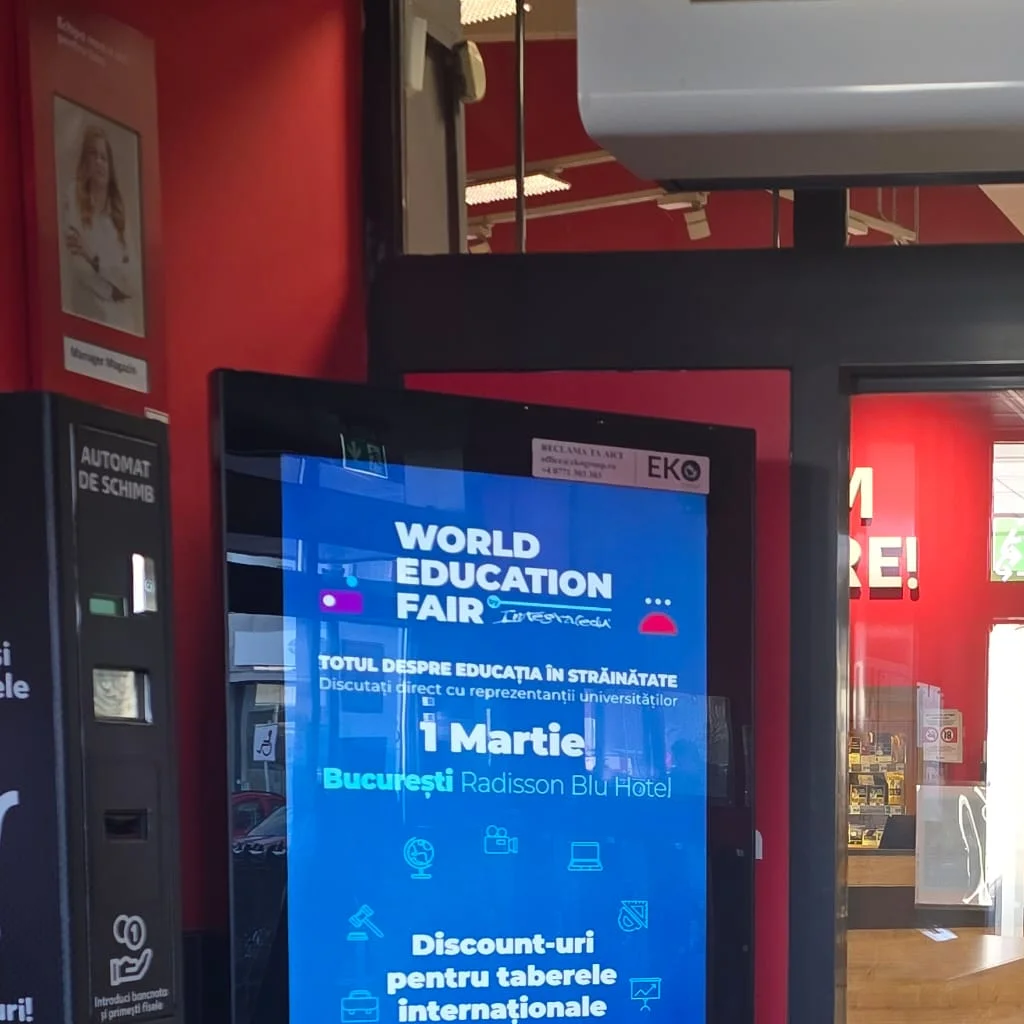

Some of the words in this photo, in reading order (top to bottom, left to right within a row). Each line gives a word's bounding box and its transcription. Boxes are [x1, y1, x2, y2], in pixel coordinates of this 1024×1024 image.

[81, 446, 151, 478] AUTOMAT
[79, 470, 99, 492] DE
[102, 475, 155, 503] SCHIMB
[395, 522, 540, 558] WORLD
[396, 558, 612, 598] EDUCATION
[397, 593, 484, 624] FAIR
[0, 641, 10, 666] i
[319, 656, 378, 673] TOTUL
[382, 659, 452, 676] DESPRE
[455, 662, 543, 685] EDUCAȚIA
[546, 664, 564, 682] ÎN
[568, 667, 678, 688] STRĂINĂTATE
[319, 677, 391, 695] Discutați
[396, 680, 441, 696] direct
[446, 686, 465, 696] cu
[469, 686, 576, 705] reprezentanții
[580, 691, 678, 708] universităților
[419, 720, 438, 752] 1
[450, 722, 586, 757] Martie
[323, 767, 453, 799] București
[461, 771, 563, 795] Radisson
[572, 775, 607, 797] Blu
[615, 777, 671, 799] Hotel
[412, 930, 595, 956] Discount-uri
[387, 968, 489, 994] pentru
[496, 964, 617, 988] taberele
